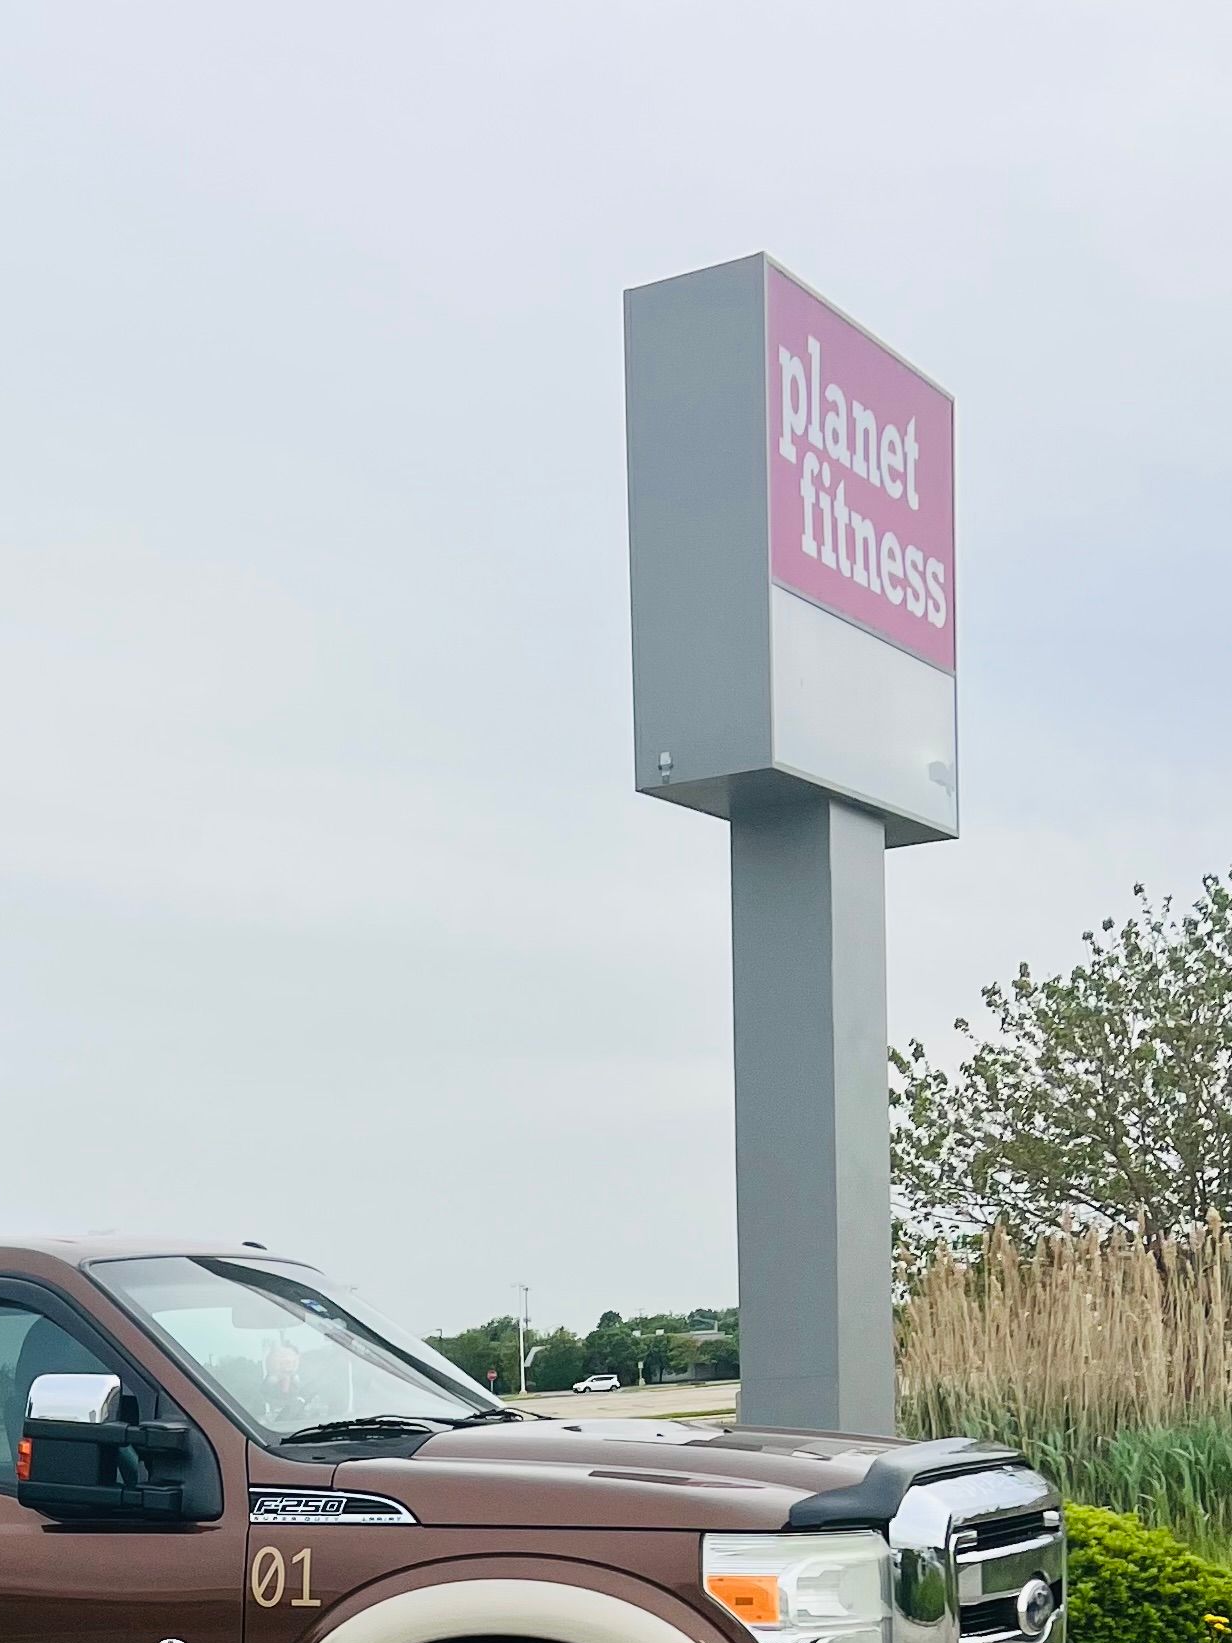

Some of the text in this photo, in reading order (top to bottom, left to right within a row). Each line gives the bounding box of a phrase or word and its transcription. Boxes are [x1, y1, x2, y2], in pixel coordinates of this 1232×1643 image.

[779, 335, 919, 510] planet
[800, 451, 947, 629] fitness
[251, 1546, 321, 1607] 01
